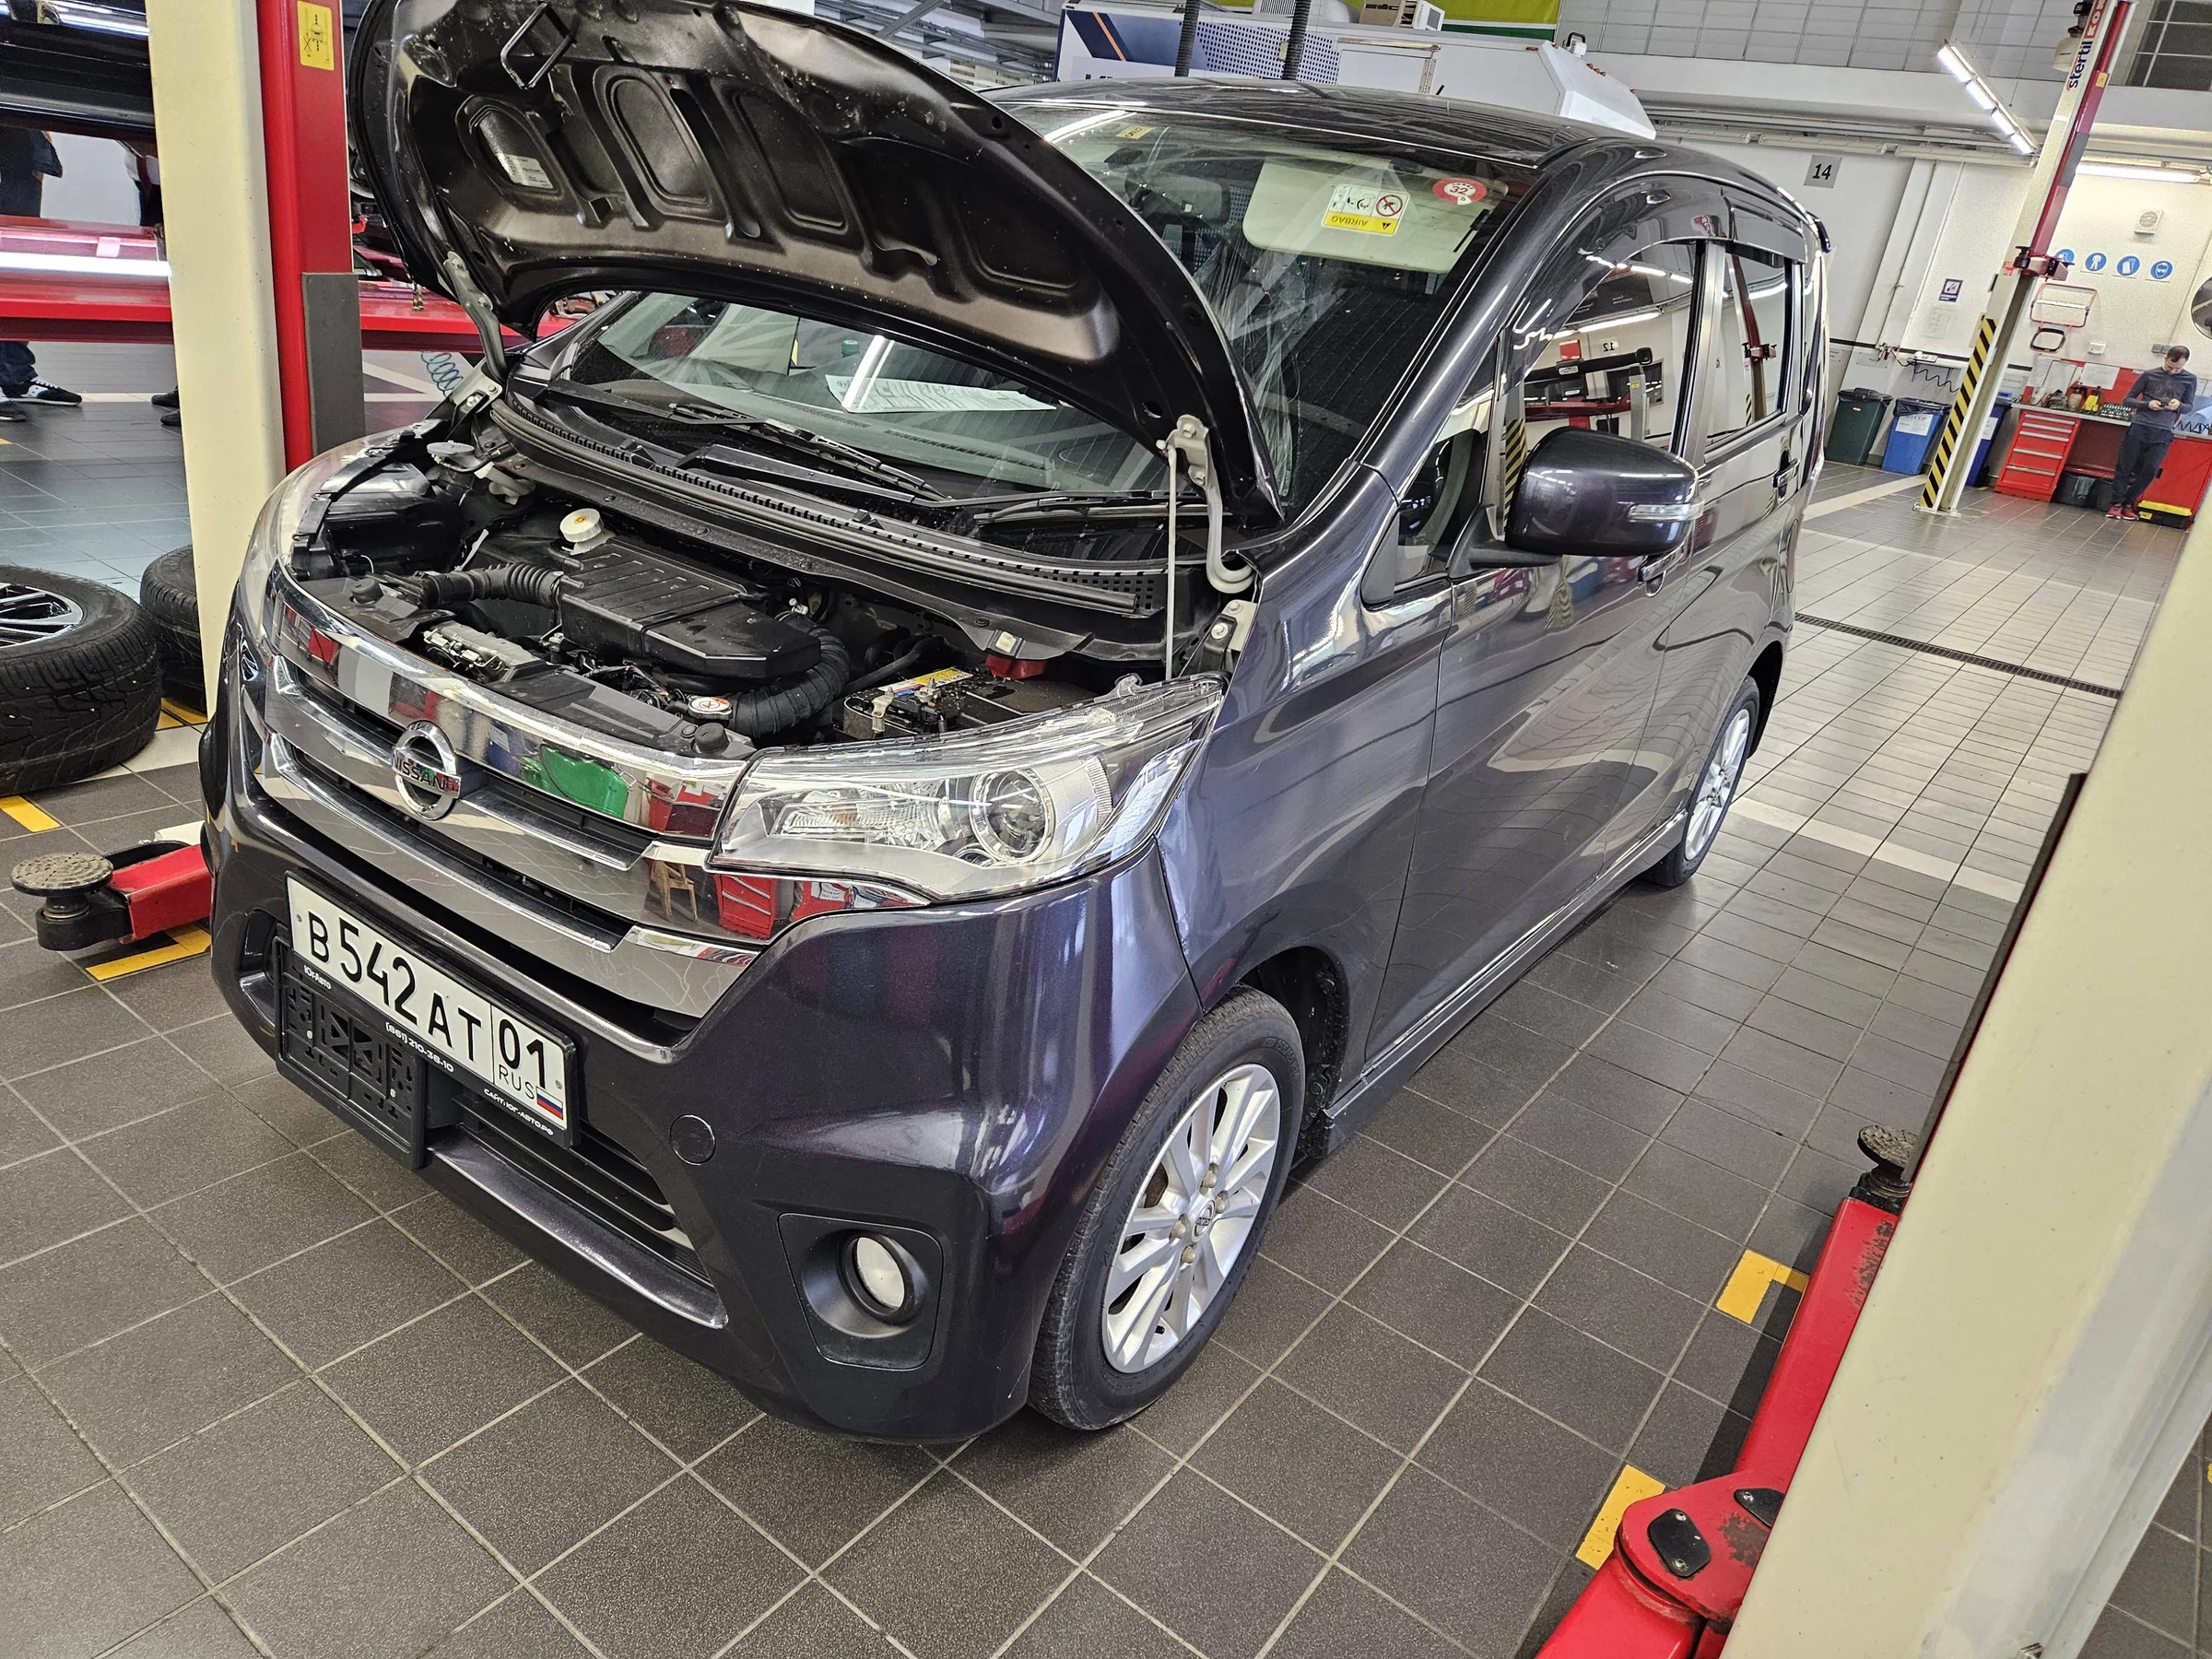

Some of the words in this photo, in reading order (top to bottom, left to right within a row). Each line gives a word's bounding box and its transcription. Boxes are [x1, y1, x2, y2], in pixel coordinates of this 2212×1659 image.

[2068, 41, 2093, 88] stertil
[1812, 163, 1832, 180] 14
[1449, 185, 1468, 195] 32
[1331, 215, 1370, 227] AIRBAG
[392, 753, 447, 792] NISSAN
[385, 1021, 408, 1044] (861)
[499, 1018, 546, 1089] 01
[499, 1064, 535, 1100] RUS
